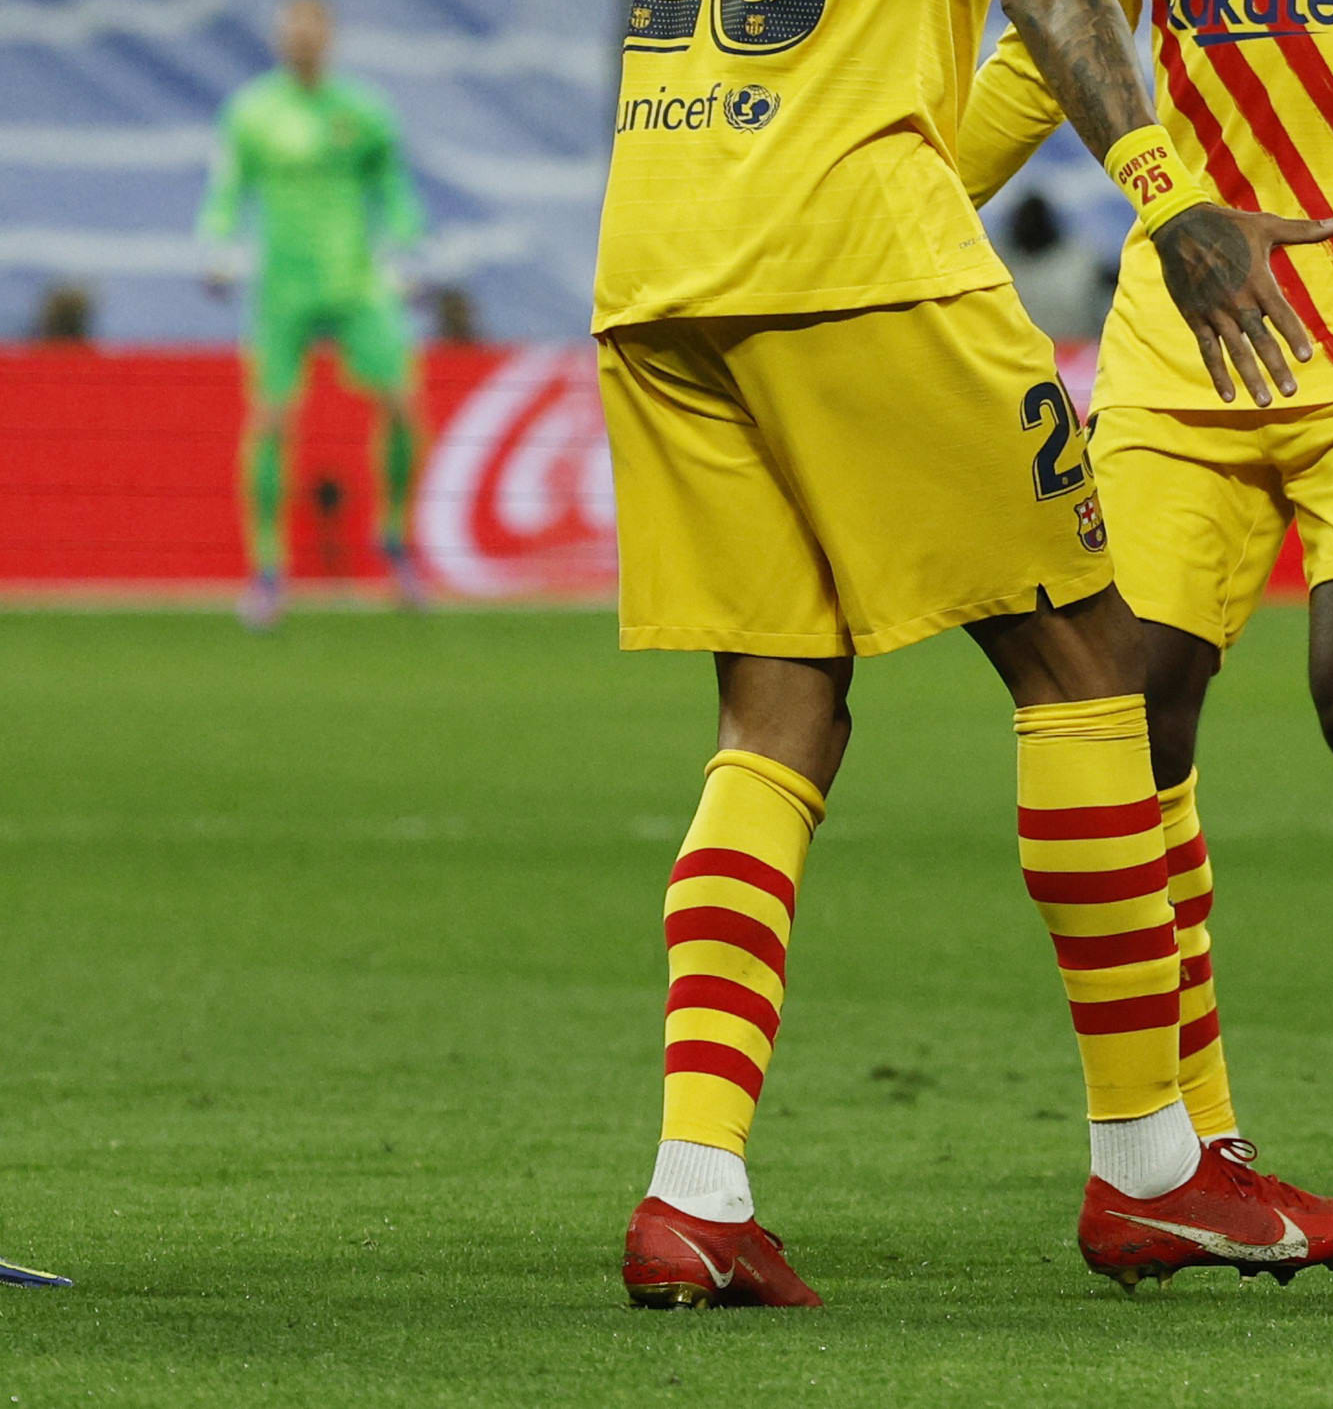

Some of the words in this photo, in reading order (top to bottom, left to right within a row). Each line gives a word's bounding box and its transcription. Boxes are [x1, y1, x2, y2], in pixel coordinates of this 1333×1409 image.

[616, 81, 722, 134] unicef
[1118, 146, 1168, 185] CURTYS
[1132, 164, 1174, 207] 25
[1020, 381, 1100, 503] 2
